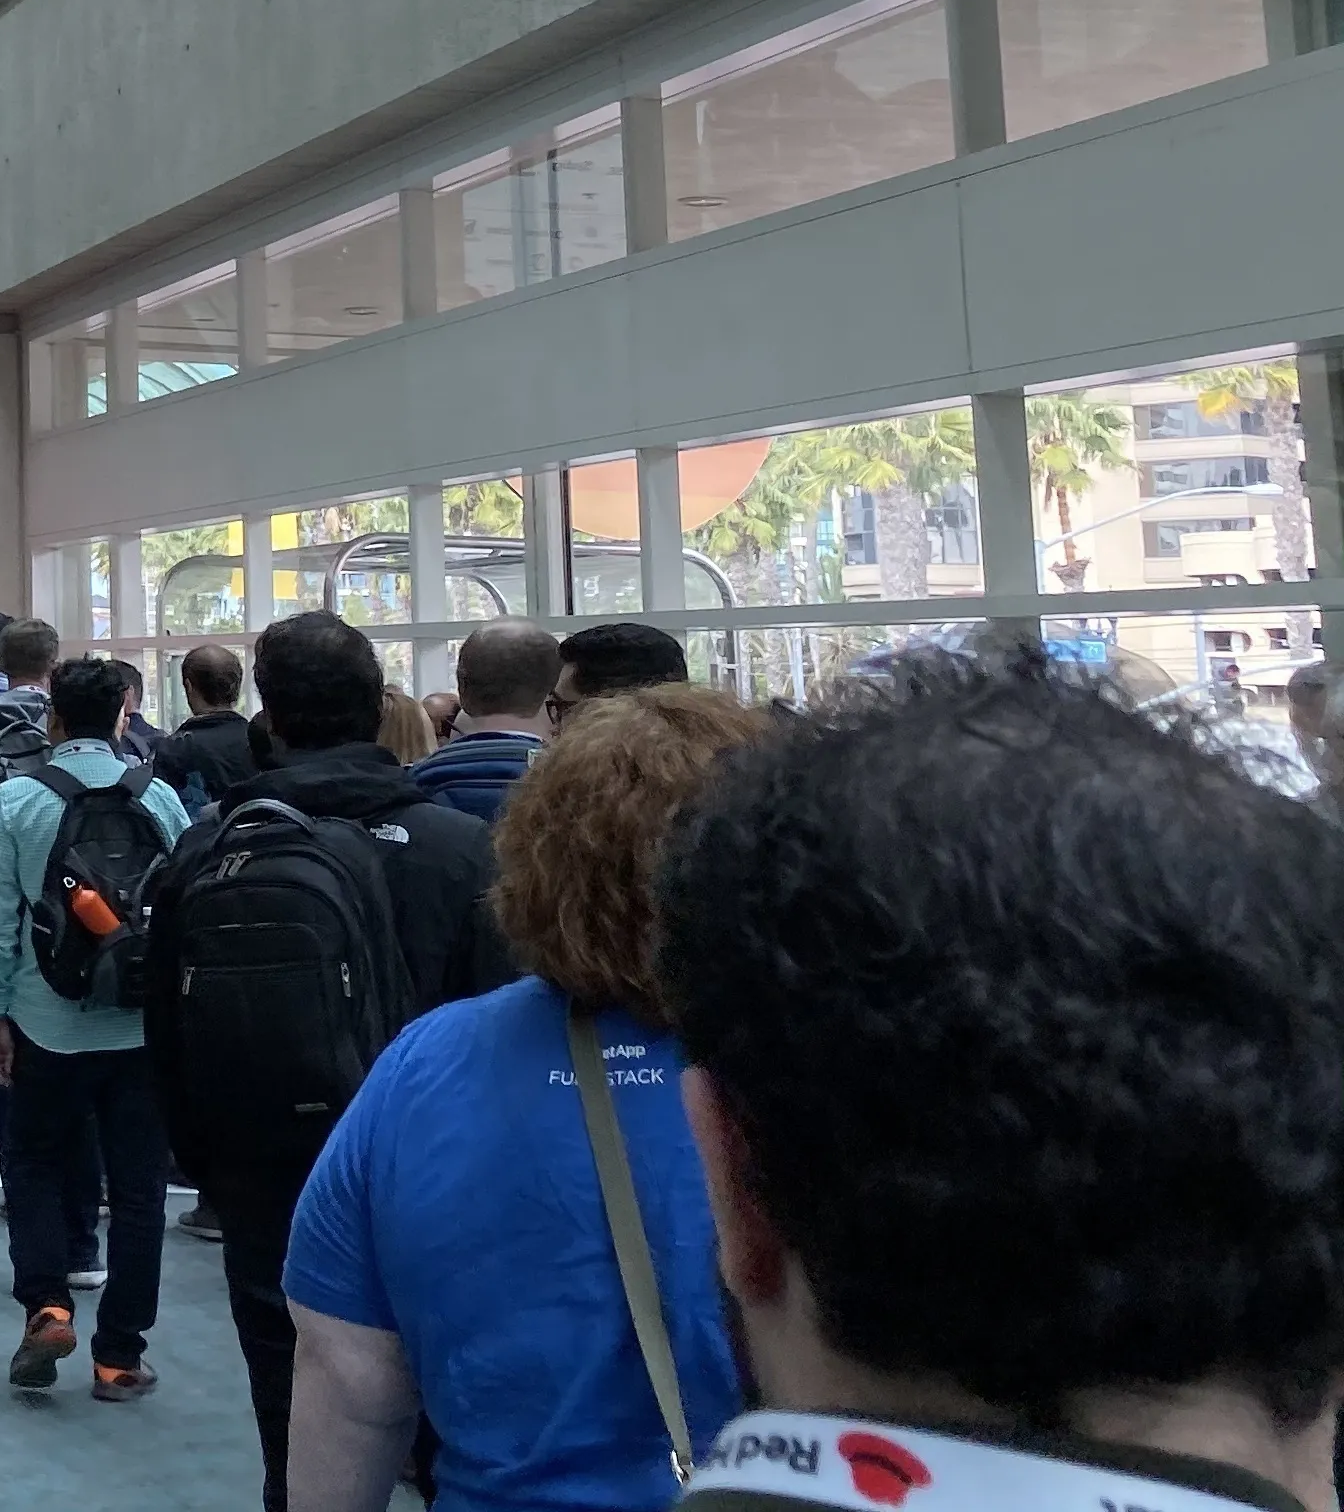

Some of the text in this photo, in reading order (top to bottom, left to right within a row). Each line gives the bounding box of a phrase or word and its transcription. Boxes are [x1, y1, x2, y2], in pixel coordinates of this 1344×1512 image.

[602, 1044, 647, 1060] etApp
[548, 1069, 579, 1086] FU
[734, 1431, 821, 1476] Red
